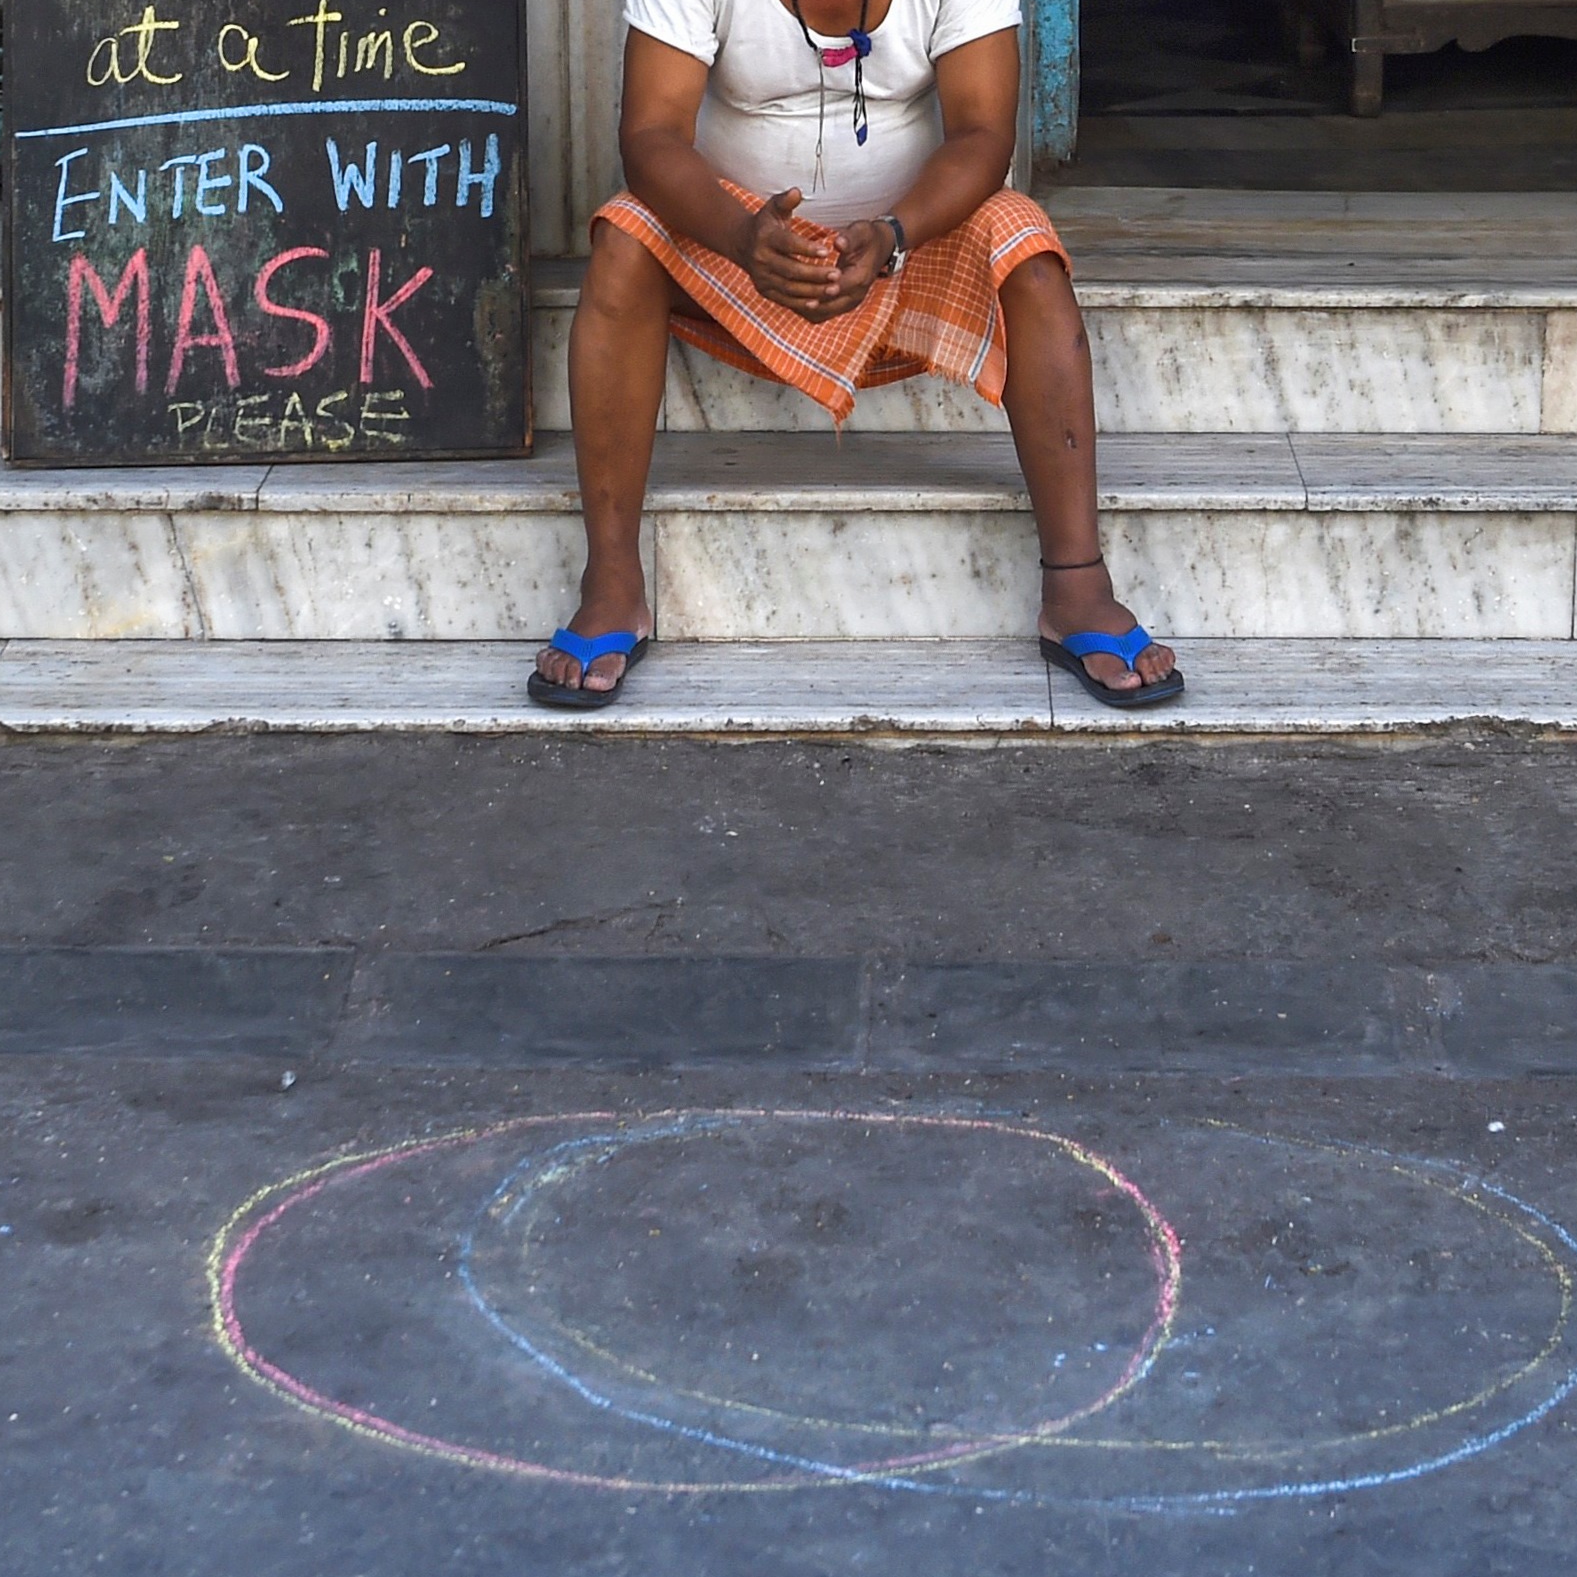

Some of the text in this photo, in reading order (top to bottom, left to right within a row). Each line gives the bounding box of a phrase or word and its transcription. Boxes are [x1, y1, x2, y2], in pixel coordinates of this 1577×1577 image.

[86, 7, 183, 88] at
[217, 23, 289, 81] a
[52, 133, 501, 243] ENTER WITH
[63, 245, 436, 409] MASK
[167, 389, 411, 453] PLEASE
